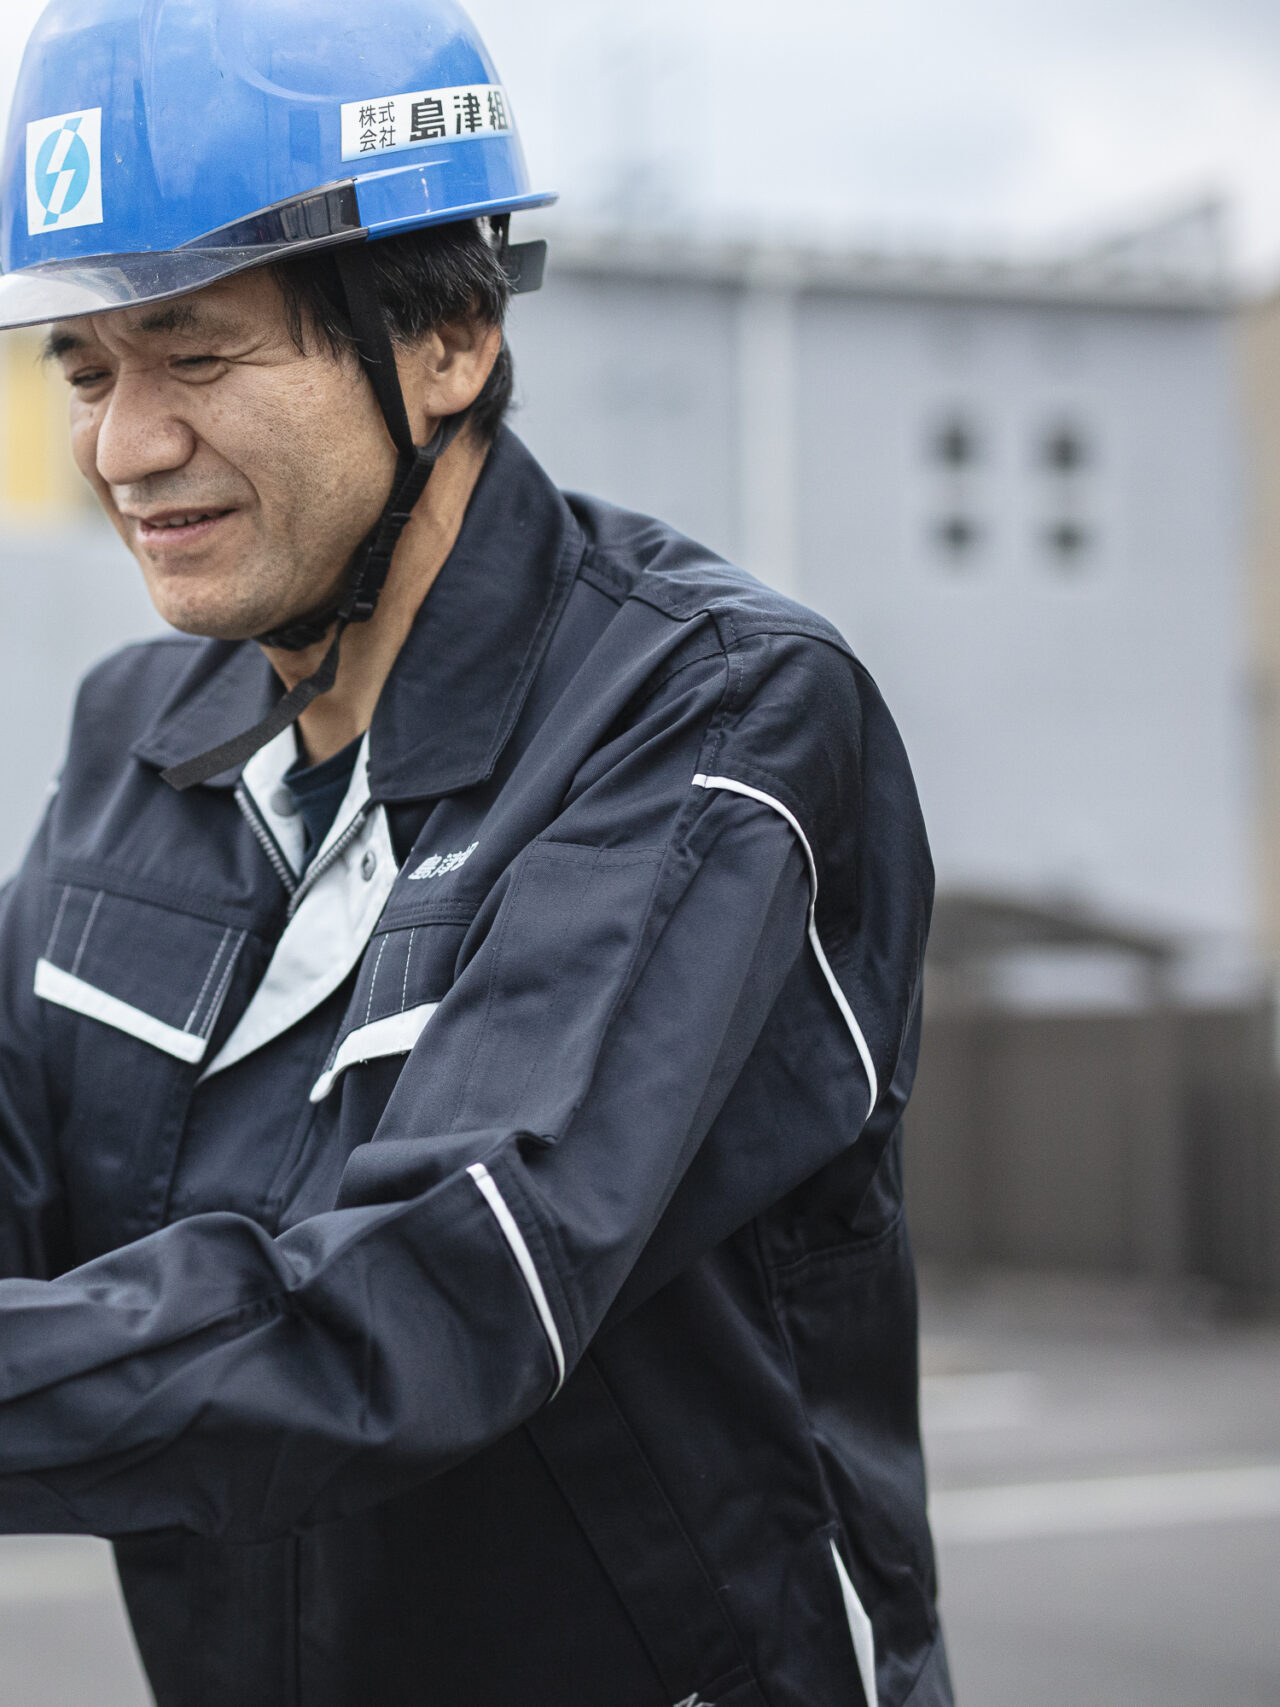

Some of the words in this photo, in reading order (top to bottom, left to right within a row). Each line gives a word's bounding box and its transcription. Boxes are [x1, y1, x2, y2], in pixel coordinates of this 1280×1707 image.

[359, 101, 395, 128] 株式
[409, 90, 508, 142] 島津組
[359, 125, 396, 153] 会社
